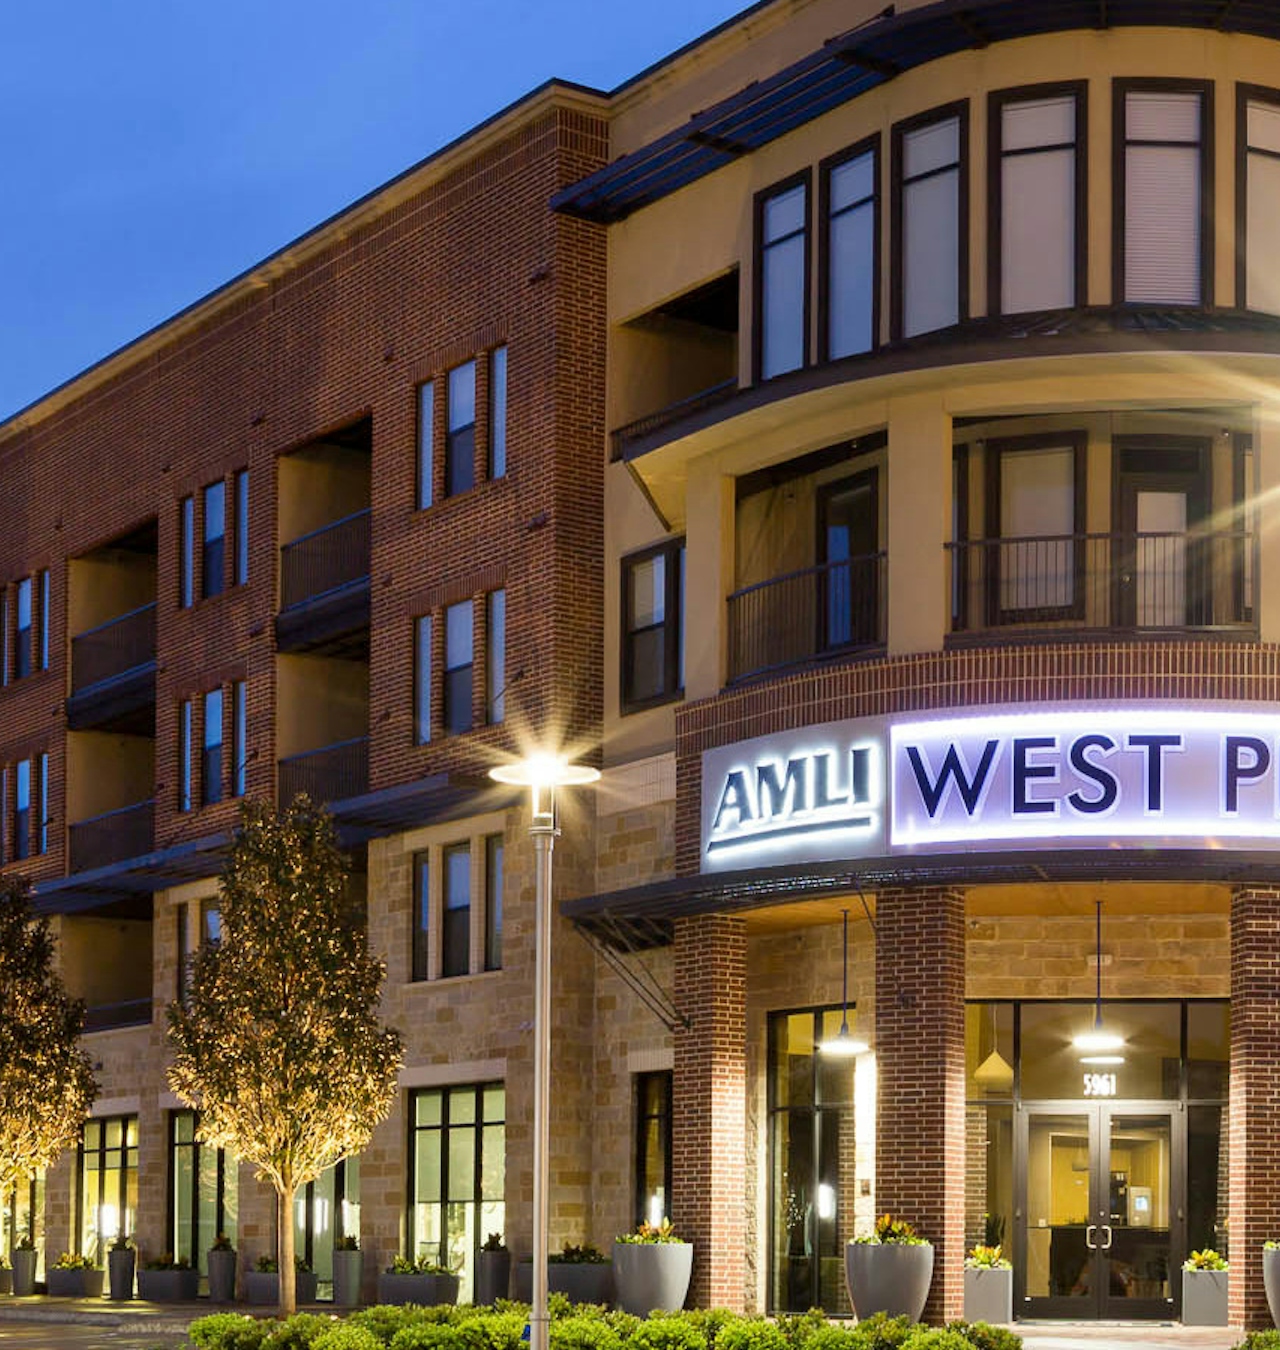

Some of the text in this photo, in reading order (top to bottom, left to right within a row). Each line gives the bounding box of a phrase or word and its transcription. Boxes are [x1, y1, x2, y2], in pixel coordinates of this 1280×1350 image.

[713, 747, 872, 830] AMLI
[905, 733, 1182, 819] WEST
[1083, 1073, 1117, 1096] 5961
